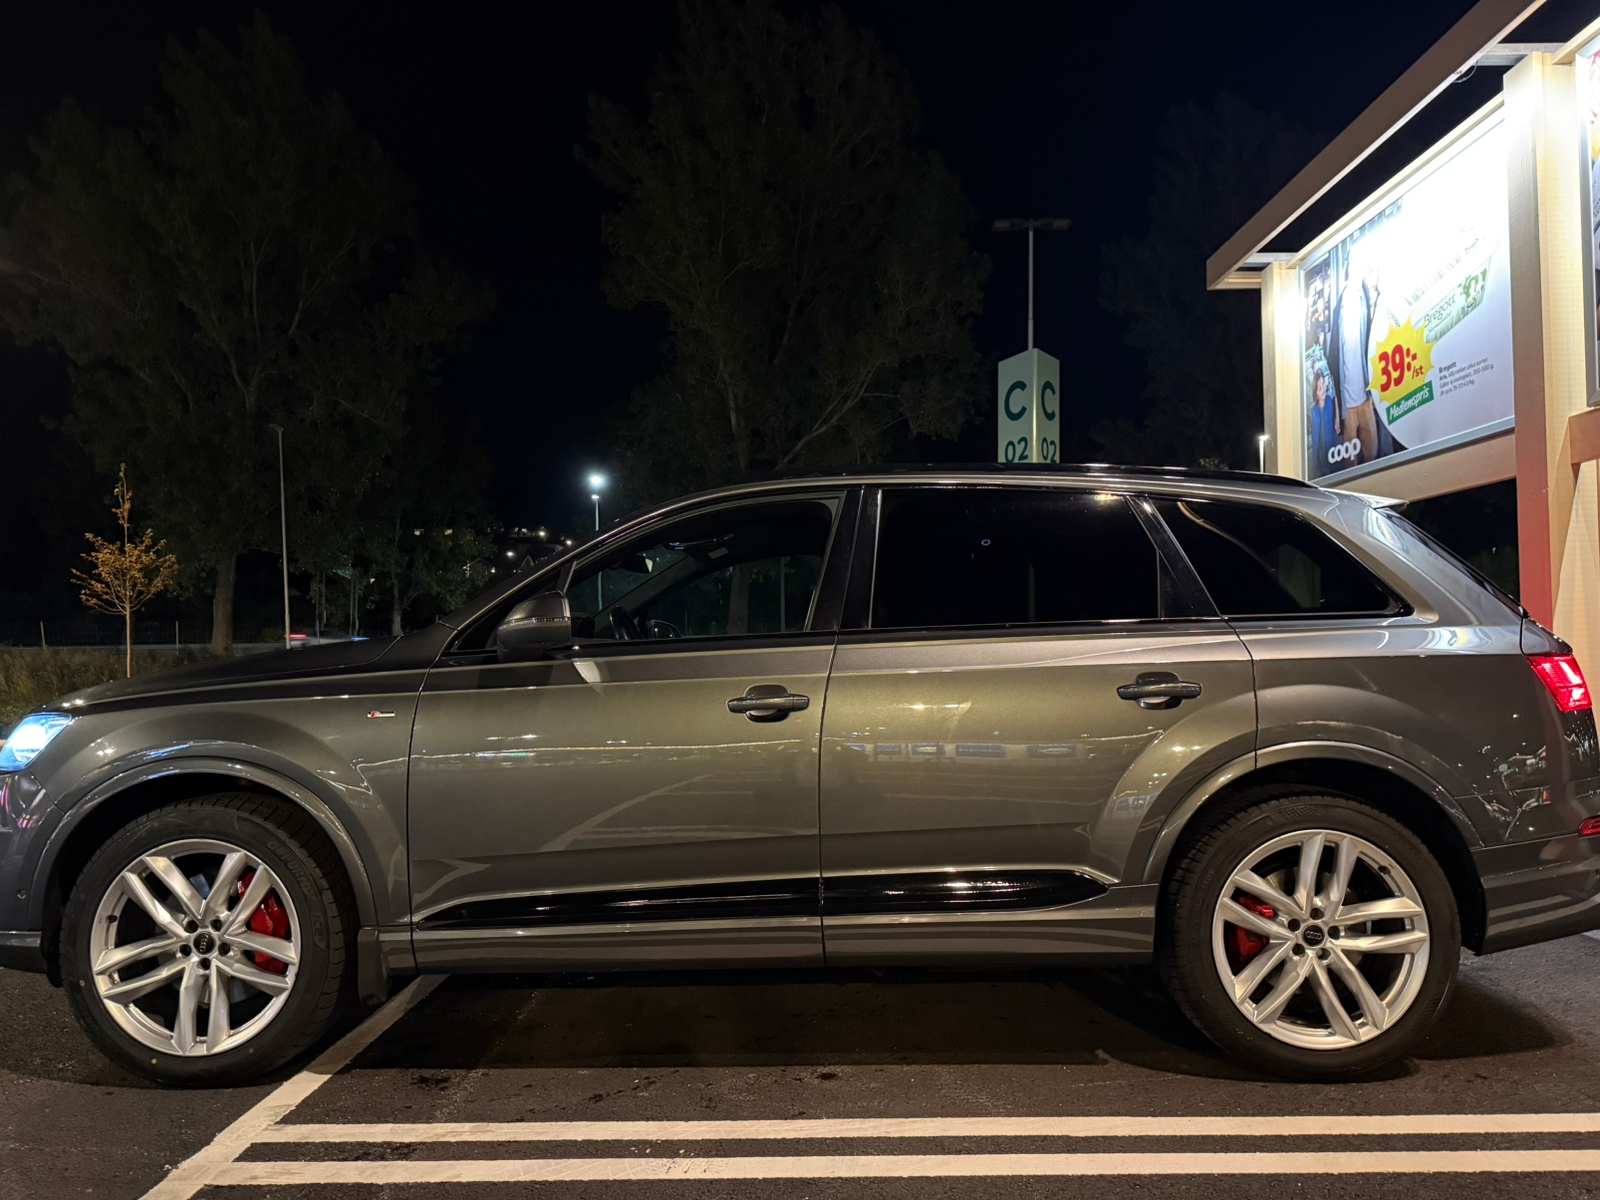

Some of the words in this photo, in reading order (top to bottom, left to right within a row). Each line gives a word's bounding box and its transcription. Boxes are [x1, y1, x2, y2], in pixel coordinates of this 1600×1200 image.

[1004, 380, 1027, 421] C
[1041, 380, 1056, 421] C
[1390, 386, 1430, 420] Medlemspris
[1004, 436, 1029, 463] 02
[1041, 437, 1057, 463] 02
[1327, 437, 1361, 464] coop
